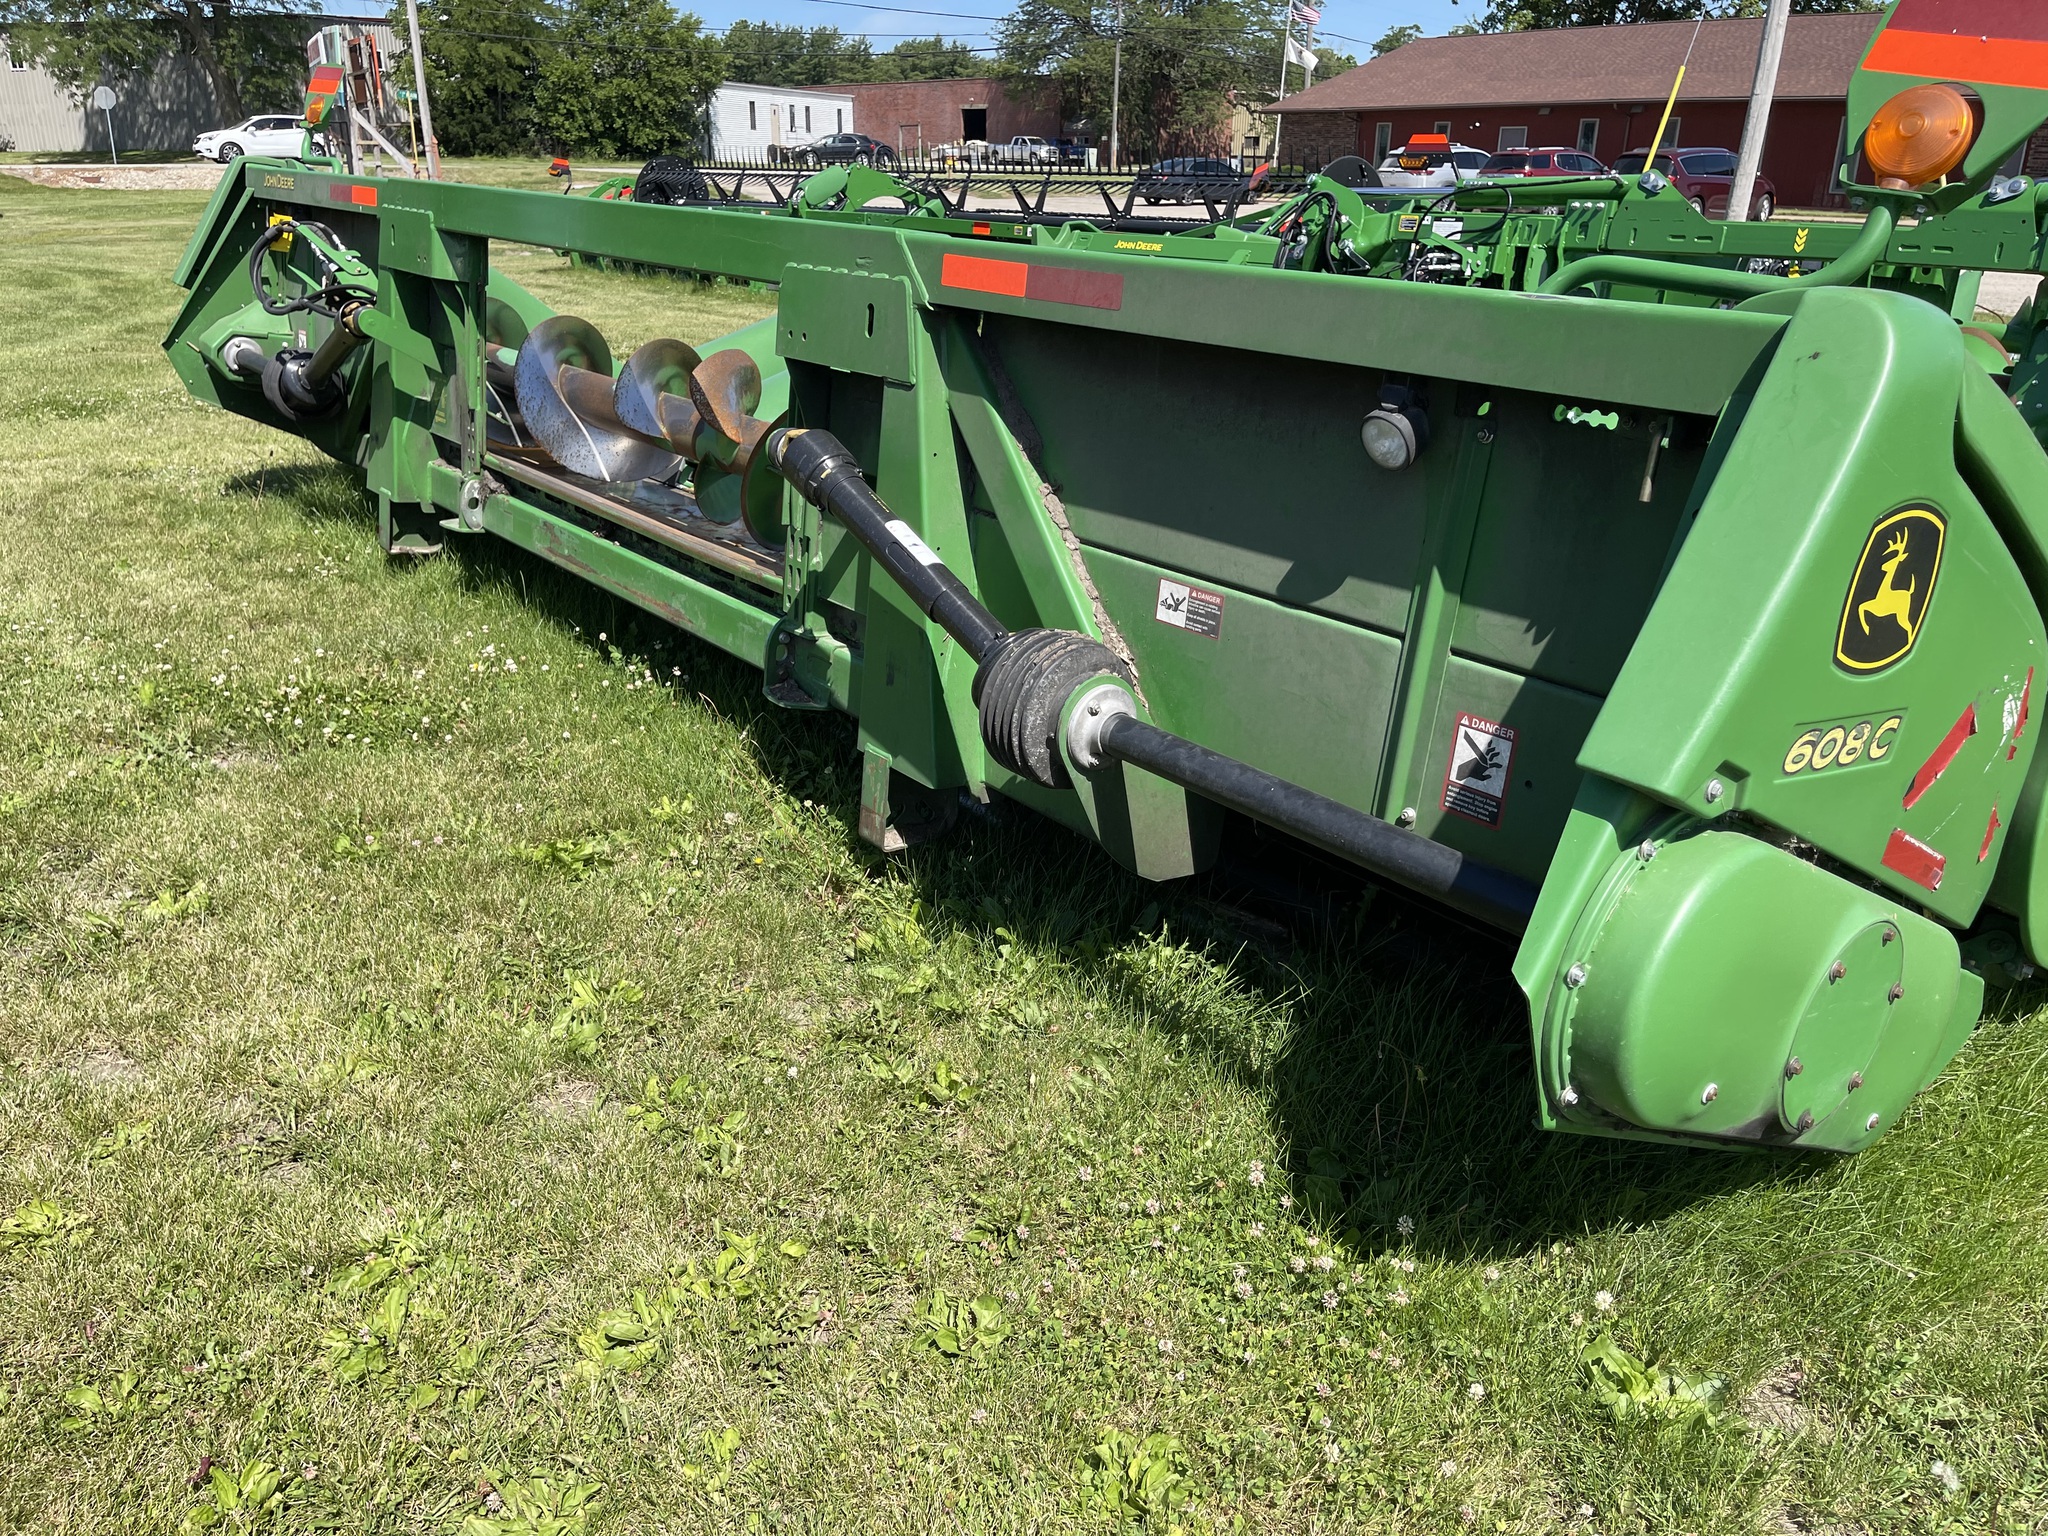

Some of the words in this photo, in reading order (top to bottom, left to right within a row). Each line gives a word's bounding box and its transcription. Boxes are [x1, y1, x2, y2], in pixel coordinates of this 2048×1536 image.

[264, 172, 277, 187] JOHN
[277, 174, 295, 190] DEERE
[1114, 240, 1136, 249] JOHN
[1136, 241, 1163, 251] DEERE
[1197, 592, 1221, 604] DANGER
[1472, 718, 1515, 740] DANGER
[1782, 715, 1903, 775] 608C
